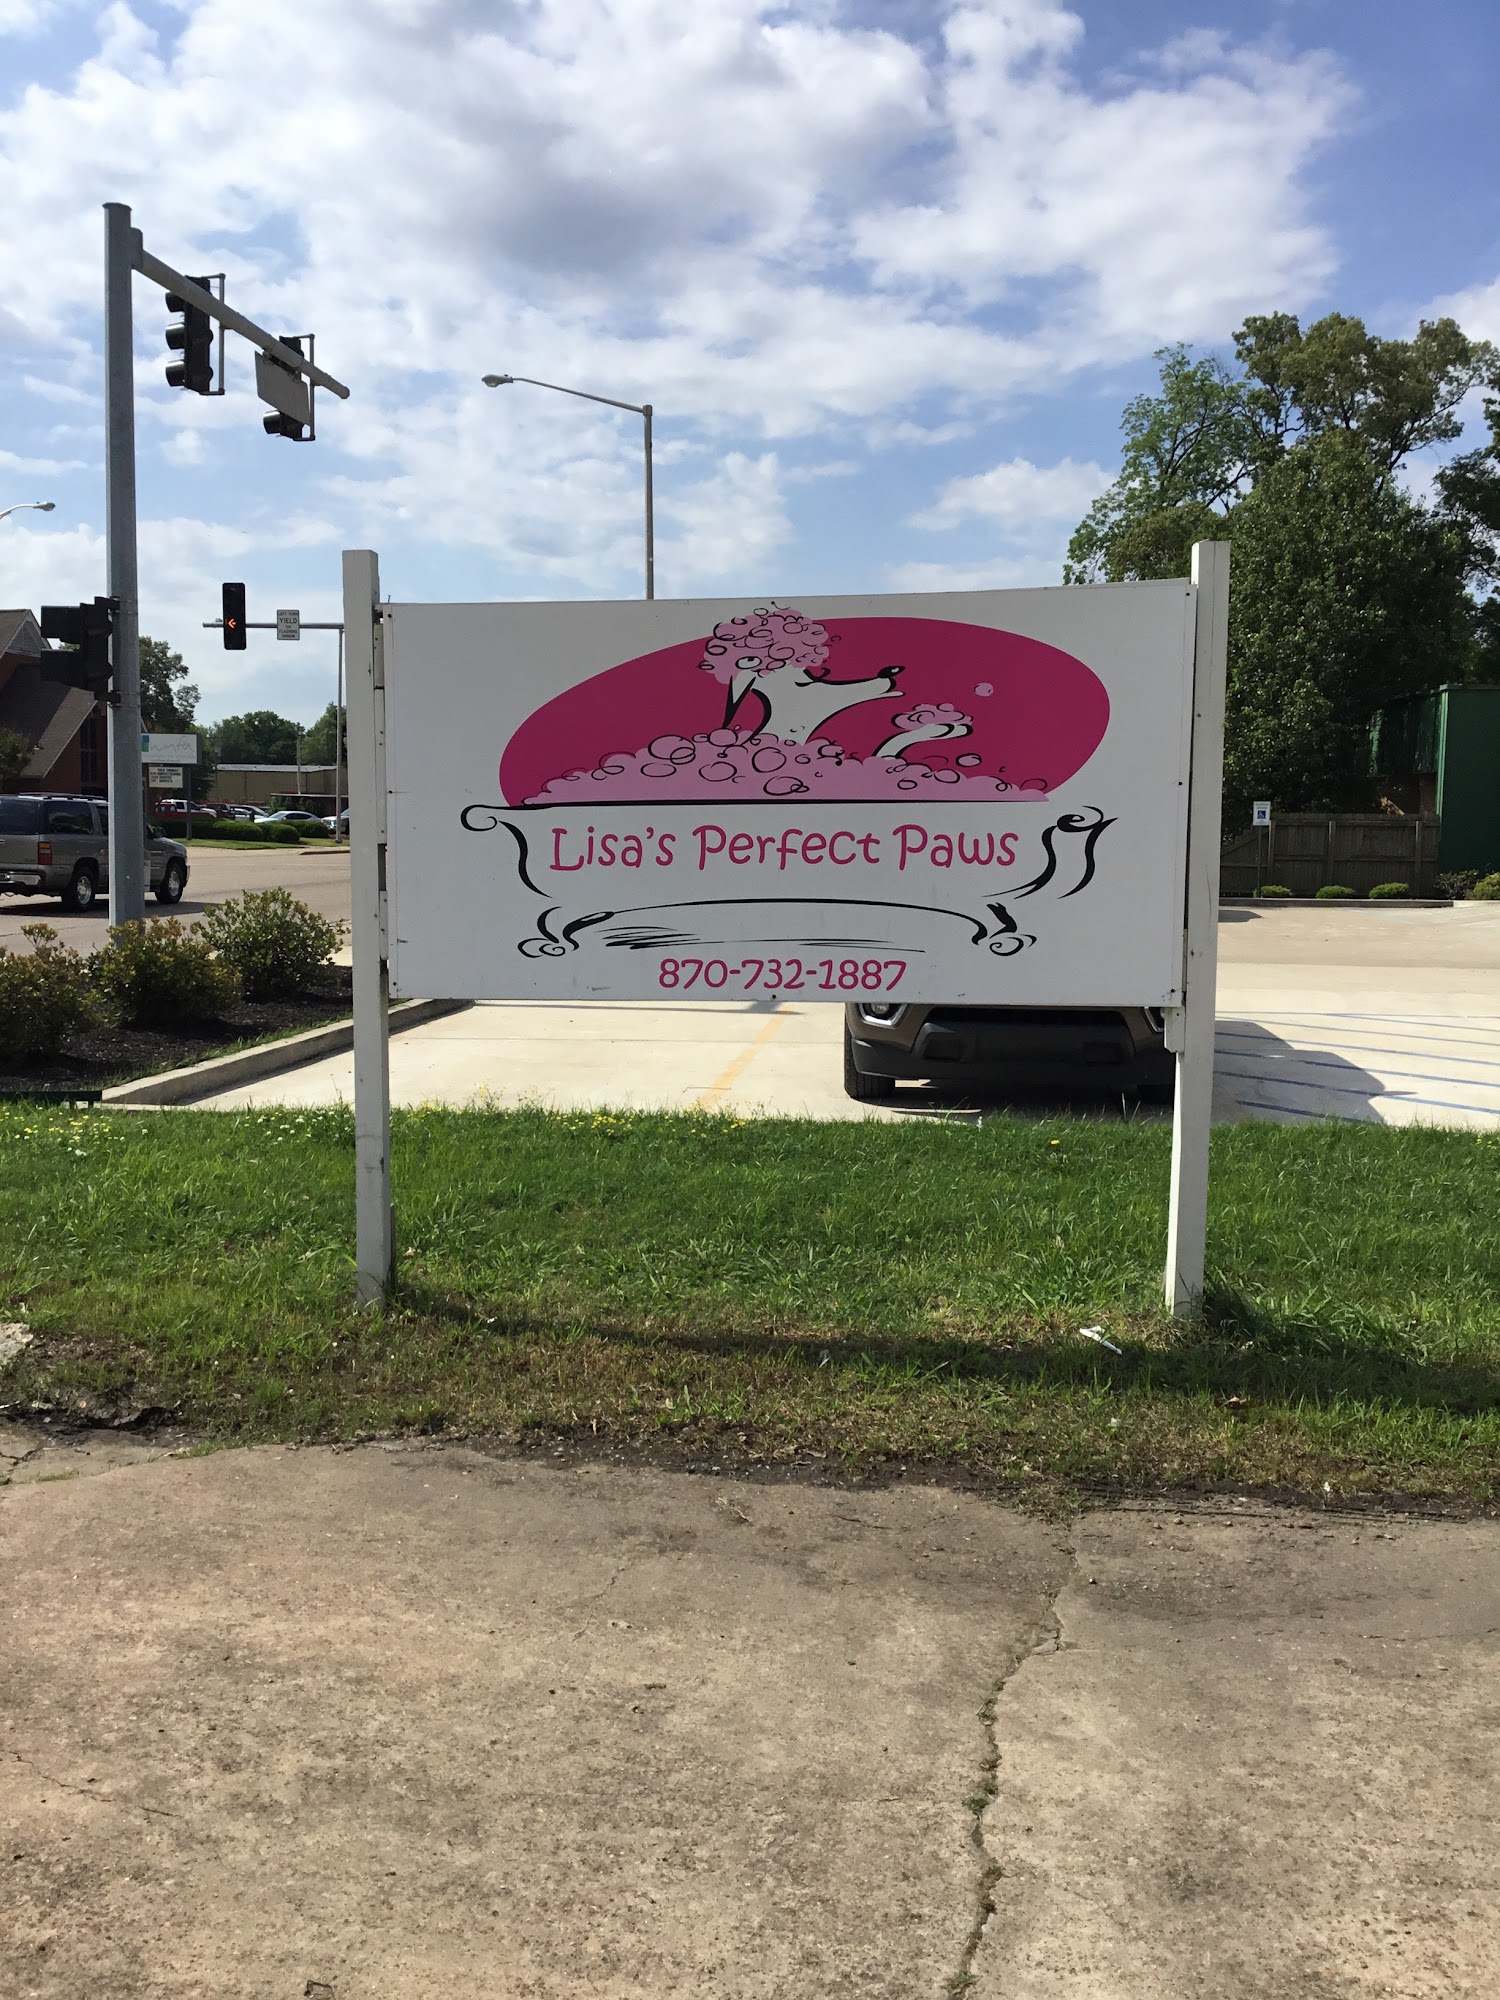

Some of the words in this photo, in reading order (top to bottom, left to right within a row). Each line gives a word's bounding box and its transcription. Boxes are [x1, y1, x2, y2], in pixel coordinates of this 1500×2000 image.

[549, 826, 676, 871] Lisa's
[692, 825, 881, 871] Perfect
[892, 824, 1019, 871] Paws
[659, 958, 908, 991] 870-732-1887
